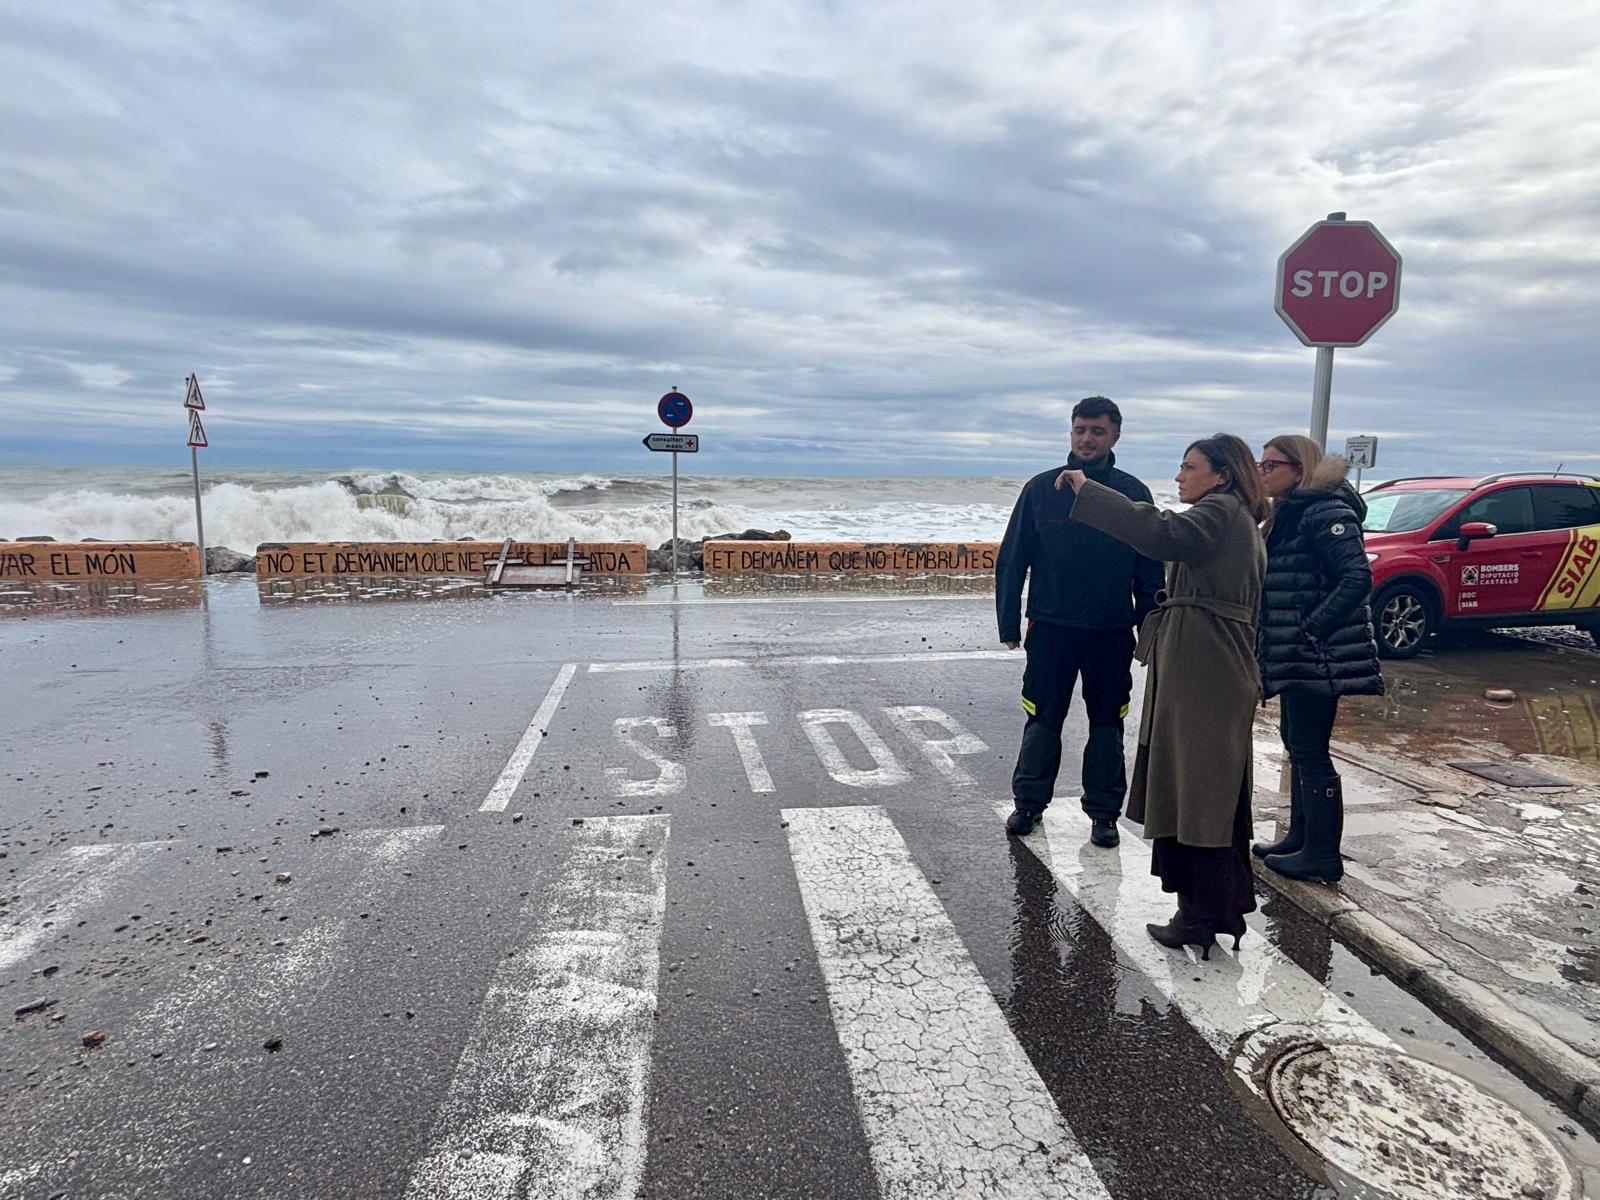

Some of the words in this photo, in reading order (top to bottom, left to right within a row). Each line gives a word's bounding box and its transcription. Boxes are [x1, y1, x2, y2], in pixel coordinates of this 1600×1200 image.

[1290, 269, 1388, 298] STOP
[50, 553, 80, 576] EL
[86, 548, 137, 576] MÓN
[267, 552, 295, 574] NO
[303, 552, 328, 573] ET
[335, 552, 419, 573] DEMANEM
[421, 551, 455, 573] QUE
[712, 550, 735, 569] ET
[741, 550, 819, 570] DEMANEM
[828, 551, 861, 571] QUE
[865, 550, 887, 569] NO
[893, 549, 994, 569] L'EMBRUTES
[1480, 564, 1519, 572] BOMBERS
[1557, 534, 1598, 599] SIAB
[605, 705, 990, 798] STOP
